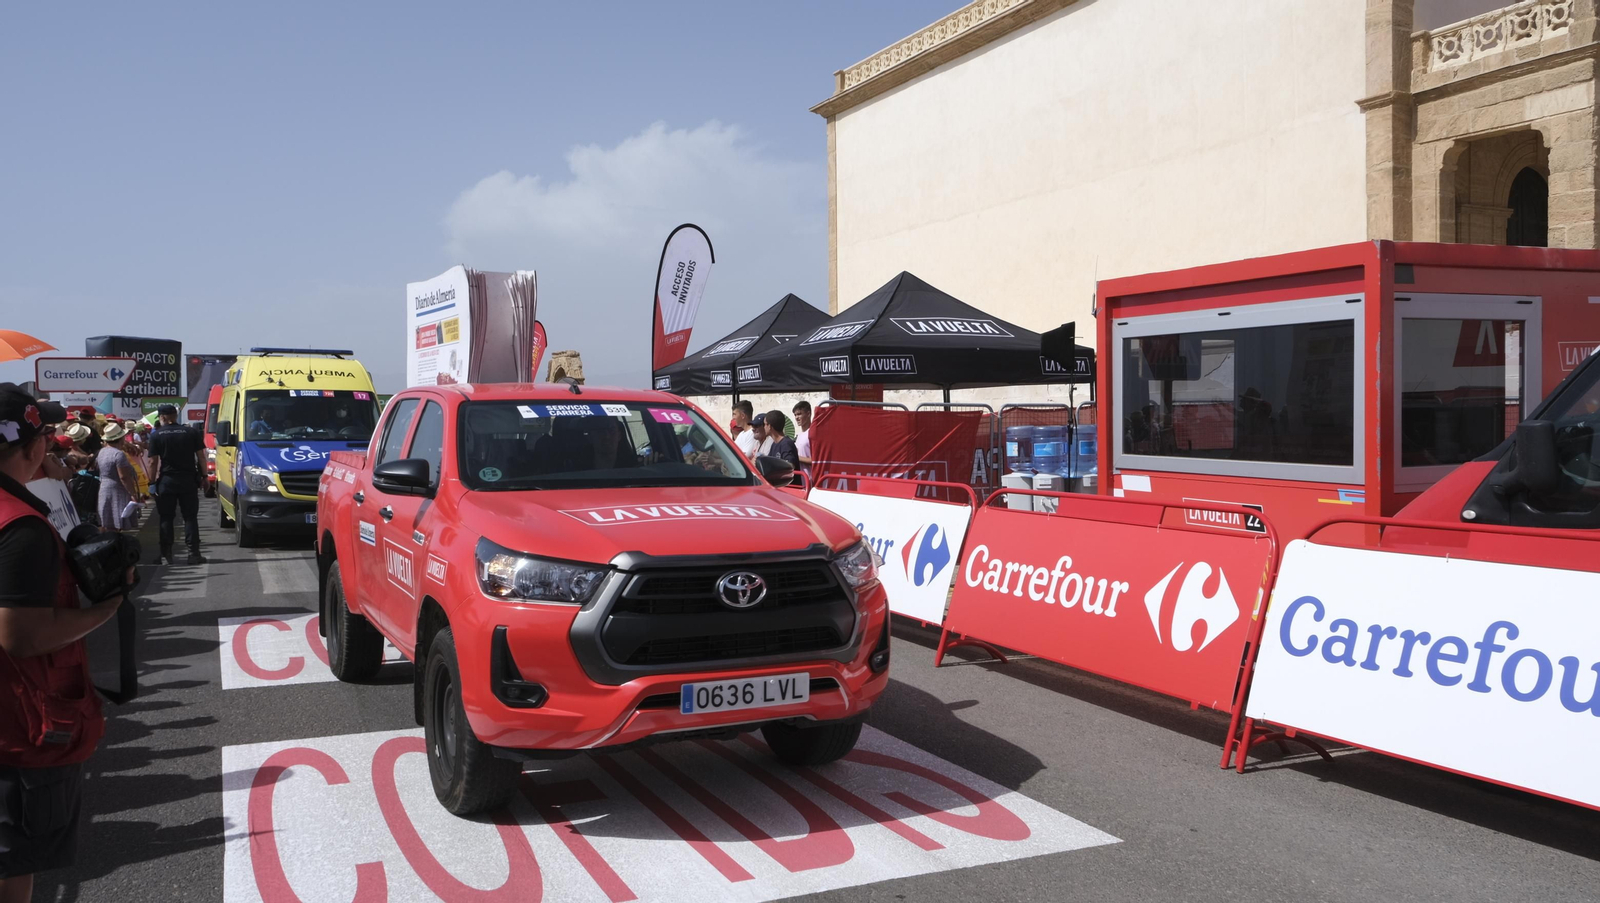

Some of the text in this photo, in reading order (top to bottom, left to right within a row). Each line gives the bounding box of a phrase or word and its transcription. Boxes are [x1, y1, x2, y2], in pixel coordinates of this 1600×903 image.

[671, 261, 686, 297] ACCESO
[678, 260, 697, 304] INVITADOS
[415, 293, 430, 310] Diario
[435, 285, 456, 305] Almería
[808, 322, 865, 341] LA VUELTA
[906, 320, 1000, 334] LA VUELTA
[865, 358, 911, 371] LA VUELTA
[1566, 347, 1579, 366] LA
[745, 367, 759, 380] VUELTA
[822, 359, 847, 373] LA VUELTA
[1045, 359, 1086, 372] LA VTA
[44, 369, 99, 380] Carrefour
[119, 383, 177, 396] ertiberia
[121, 398, 141, 408] NS
[605, 406, 628, 414] 539
[660, 411, 684, 422] 16
[589, 505, 772, 522] LA VUELTA
[1189, 508, 1201, 520] LA
[1202, 509, 1240, 525] VUELTA
[386, 547, 413, 588] LA VUELTA
[965, 543, 1129, 618] Carrefour
[1279, 595, 1600, 718] Carrefou
[696, 677, 804, 709] 0636 LVL
